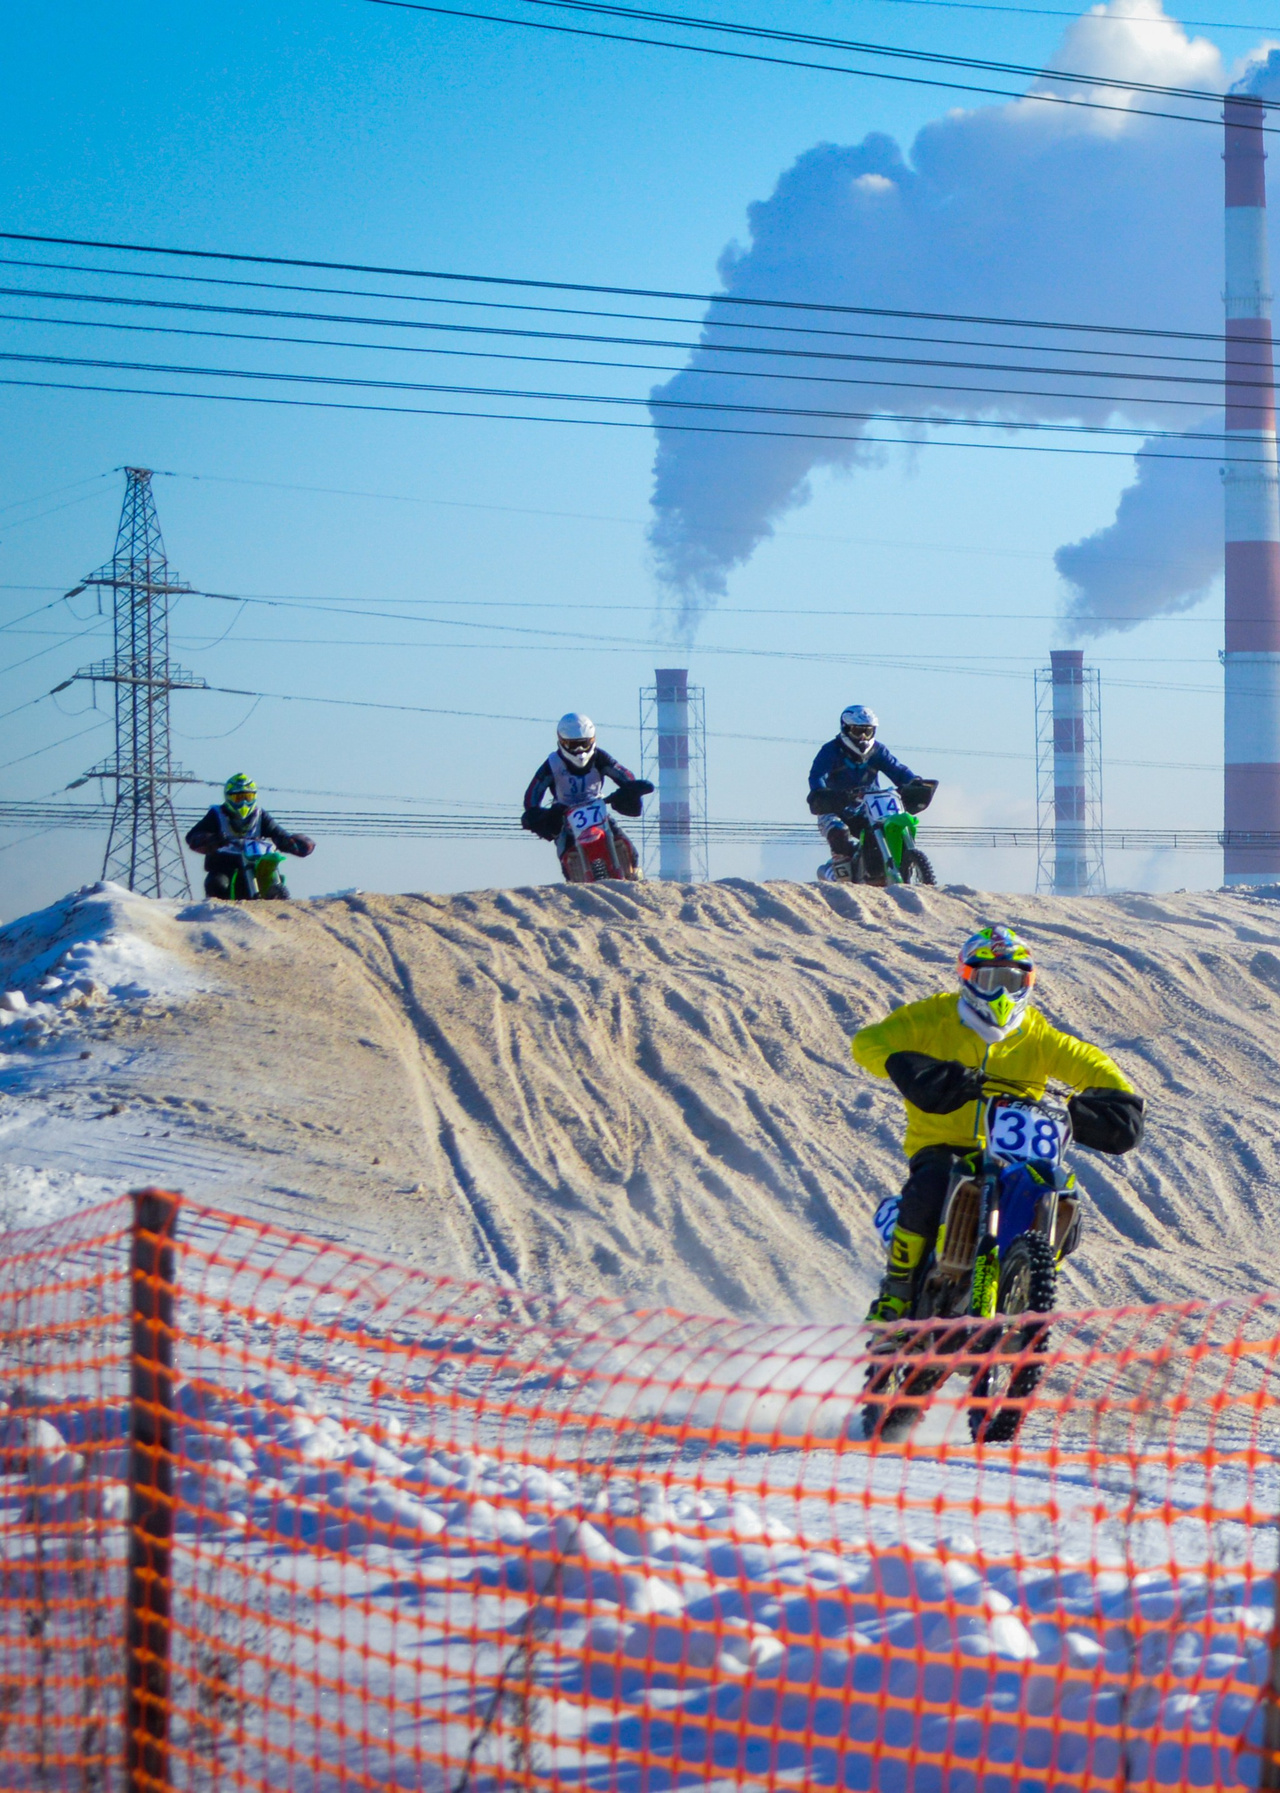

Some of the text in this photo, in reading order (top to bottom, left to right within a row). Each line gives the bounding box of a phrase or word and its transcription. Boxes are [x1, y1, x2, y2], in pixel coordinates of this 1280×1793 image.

[573, 806, 607, 828] 37
[870, 798, 899, 816] 14
[995, 1110, 1059, 1159] 38
